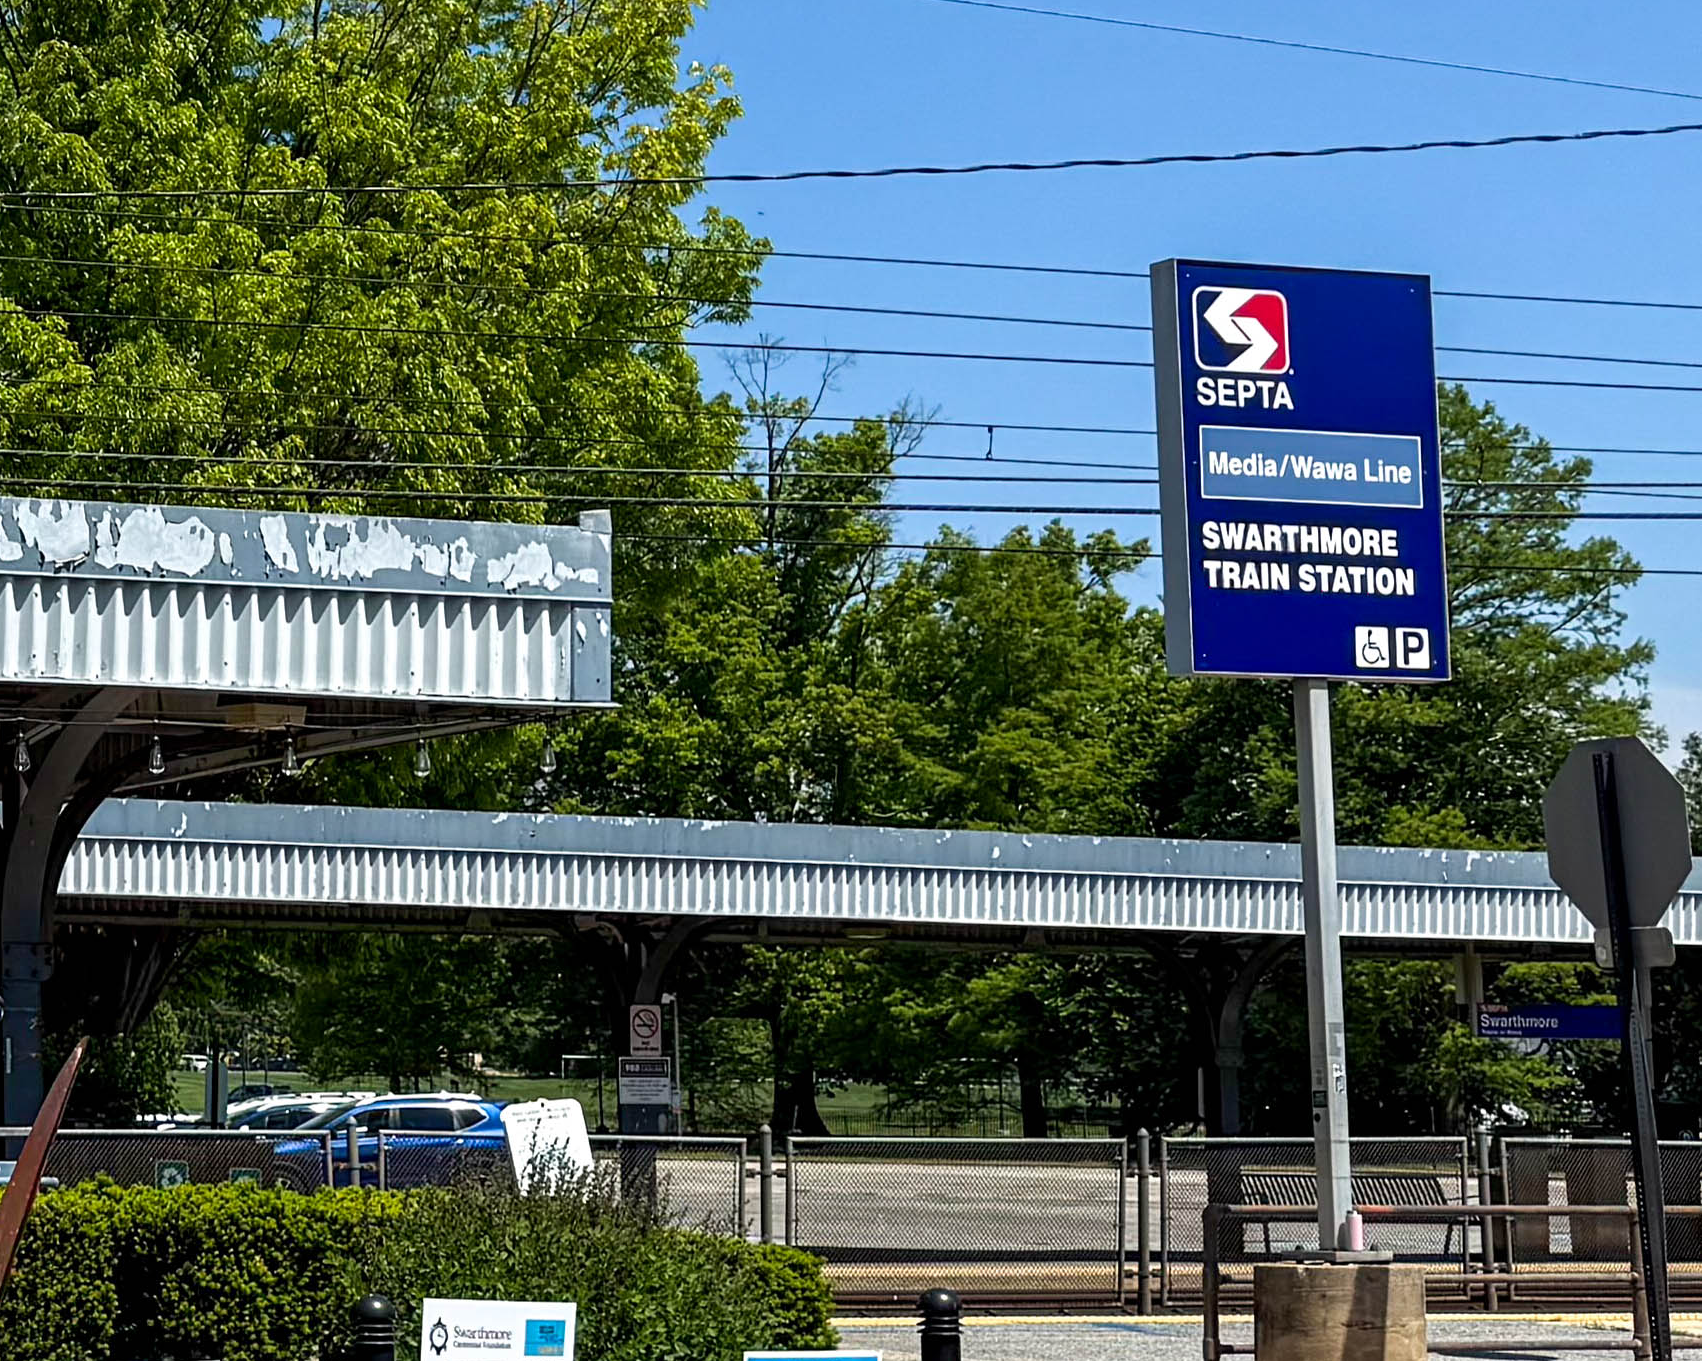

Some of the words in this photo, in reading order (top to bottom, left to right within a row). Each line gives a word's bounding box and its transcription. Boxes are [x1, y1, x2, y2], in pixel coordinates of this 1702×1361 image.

[1196, 377, 1295, 410] SEPTA
[1208, 451, 1358, 483] Media/Wawa
[1364, 459, 1413, 486] Line
[1202, 521, 1399, 557] SWARTHMORE
[1203, 560, 1291, 591] TRAIN
[1298, 566, 1416, 596] STATION
[1401, 632, 1425, 665] P
[1480, 1013, 1559, 1029] Swarthmore
